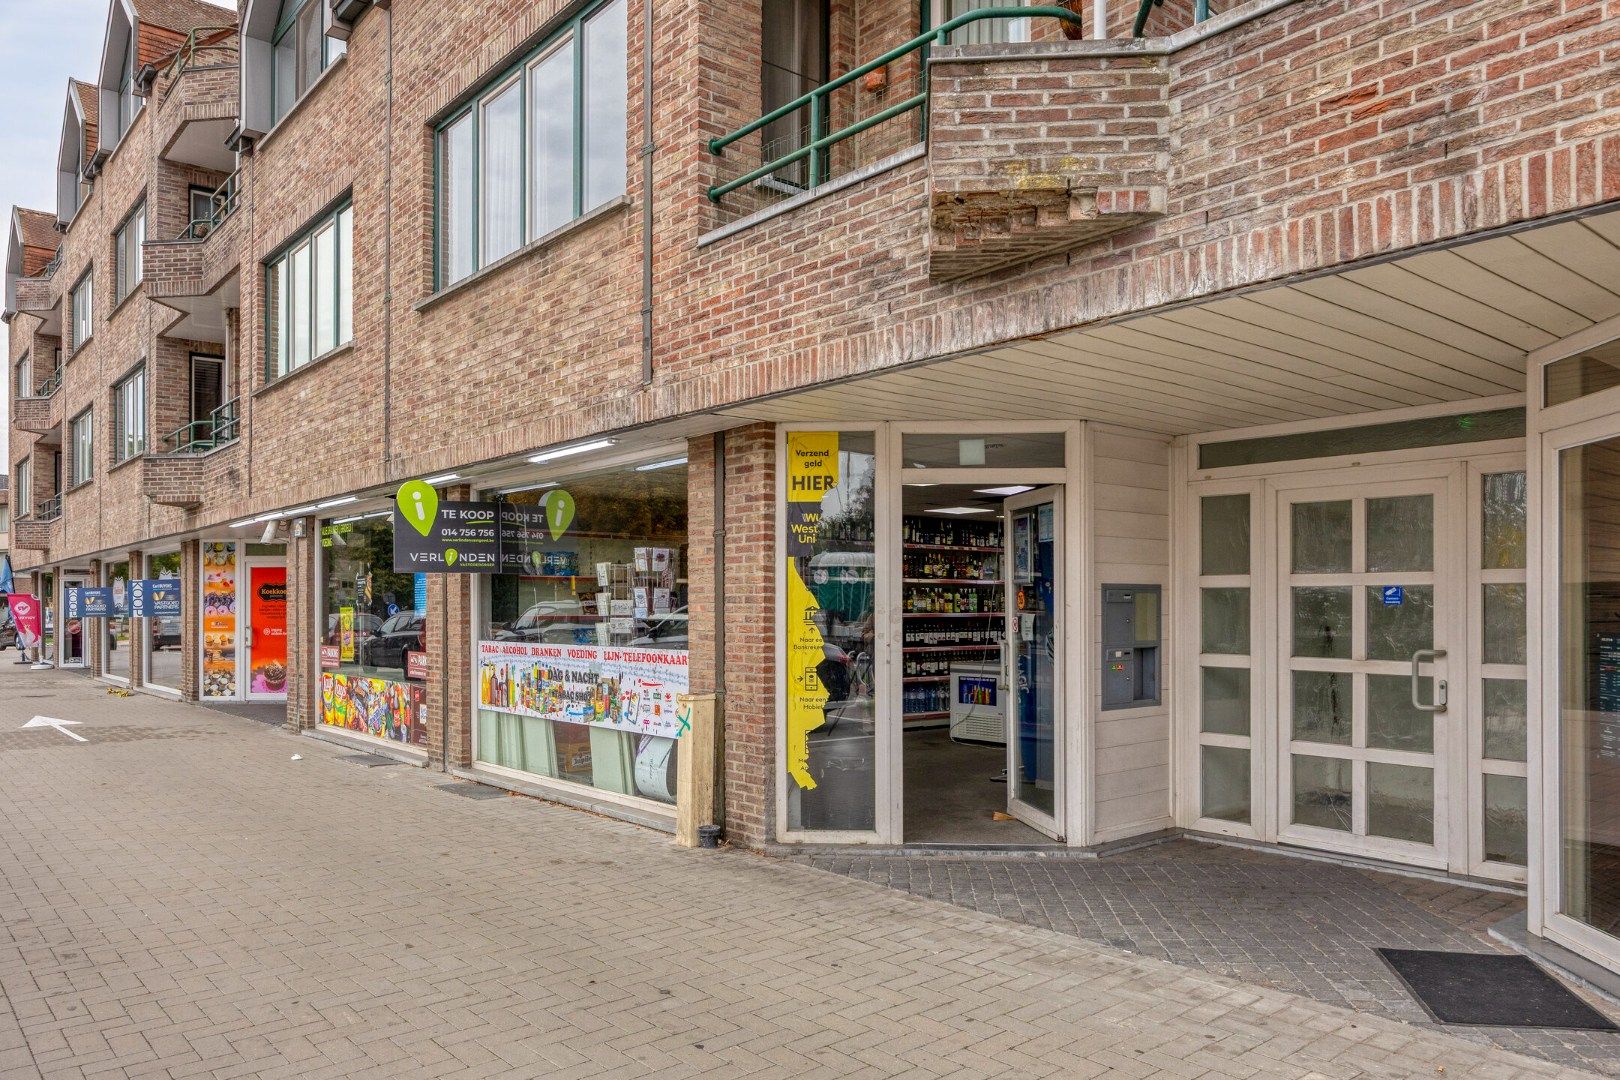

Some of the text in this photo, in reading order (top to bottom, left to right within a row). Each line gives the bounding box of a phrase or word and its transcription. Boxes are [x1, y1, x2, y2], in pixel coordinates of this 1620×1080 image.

[795, 449, 830, 457] Verzend
[804, 460, 823, 468] geld
[792, 476, 834, 490] HIER
[441, 509, 495, 520] TE KOOP
[441, 528, 495, 537] 014 756 756
[790, 524, 818, 534] West
[132, 580, 144, 617] KOOP
[481, 644, 499, 654] TABAC
[502, 646, 528, 656] ALCOHOL
[531, 647, 562, 657] DRANKEN
[567, 649, 598, 660] VOEDING
[547, 668, 564, 681] DAG
[571, 670, 600, 684] NACHT
